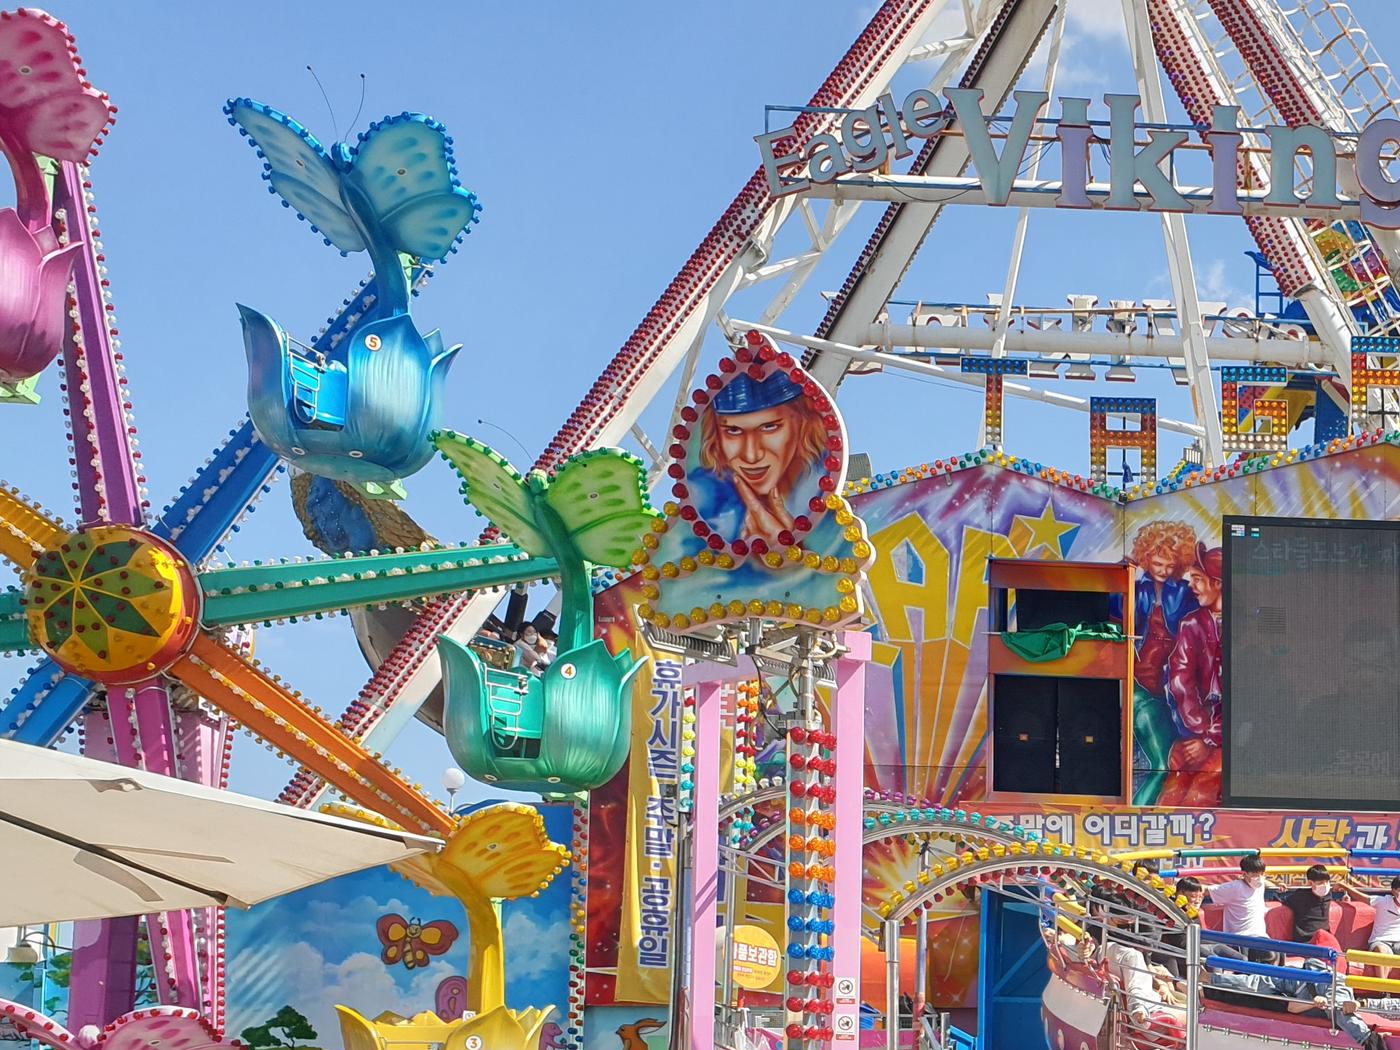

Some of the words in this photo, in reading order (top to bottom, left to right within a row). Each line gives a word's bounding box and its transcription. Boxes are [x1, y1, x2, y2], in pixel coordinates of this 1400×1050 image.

[754, 87, 950, 197] Eagle
[369, 337, 379, 348] 5
[564, 665, 573, 677] 4
[647, 661, 682, 780] 휴가시즌
[1084, 813, 1214, 845] 어디갈까?
[470, 1038, 478, 1049] 3
